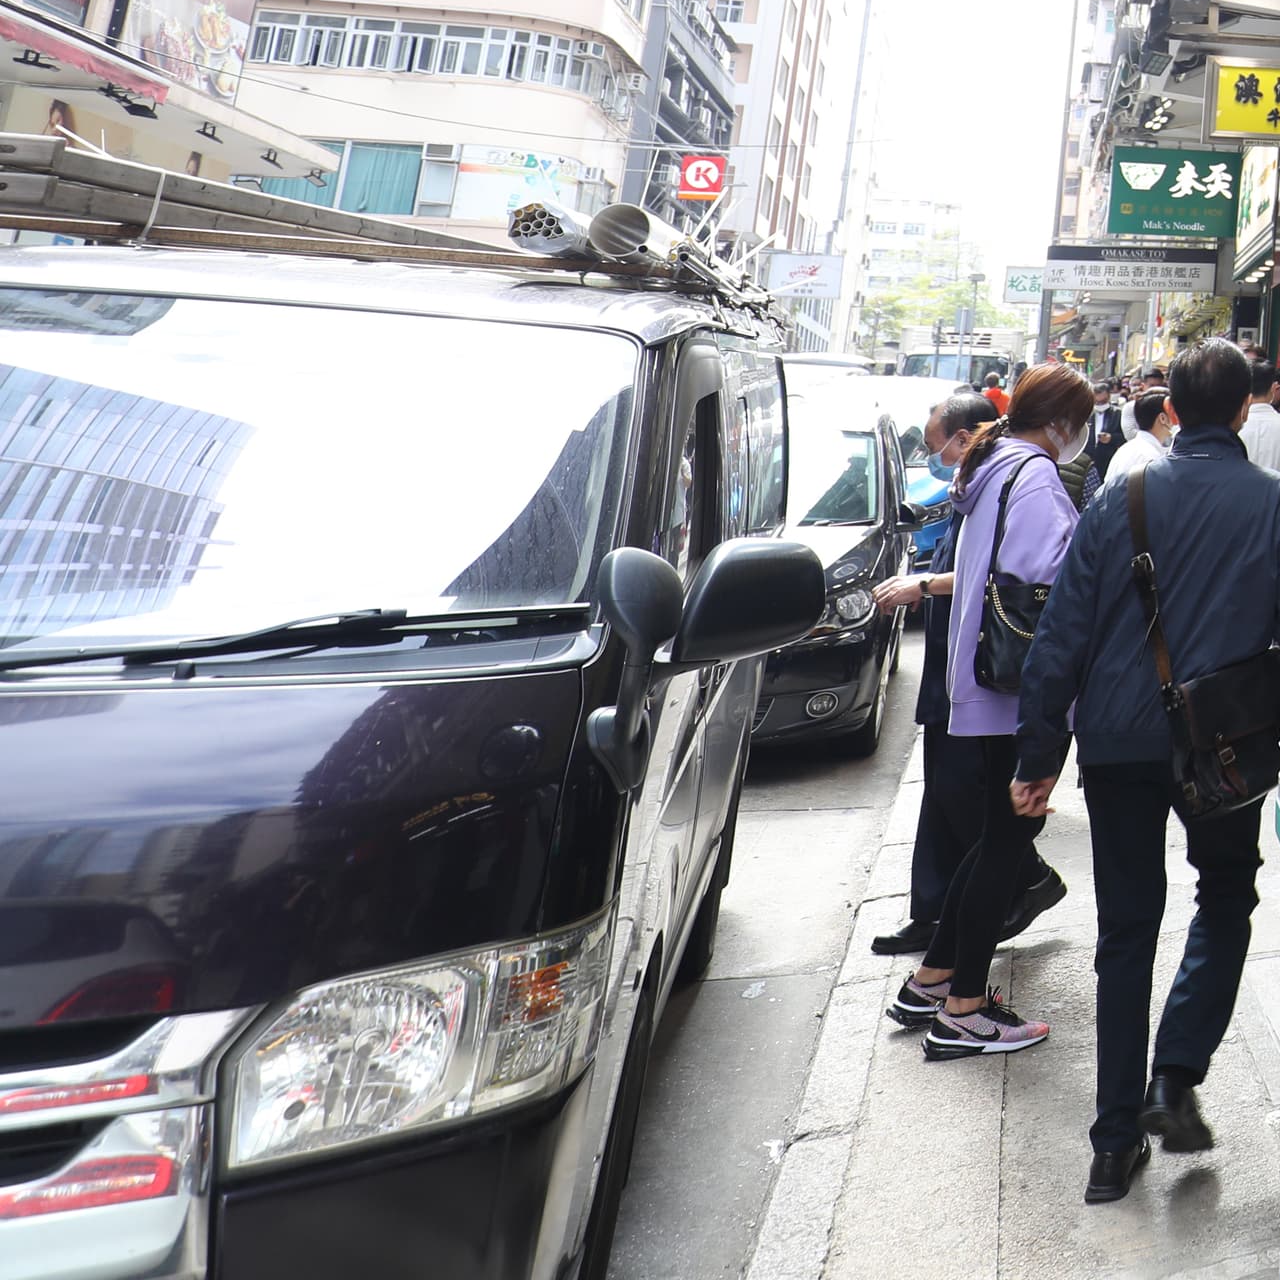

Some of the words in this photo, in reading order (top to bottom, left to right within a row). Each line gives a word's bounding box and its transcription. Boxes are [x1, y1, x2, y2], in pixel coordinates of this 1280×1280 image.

[1142, 220, 1170, 231] Mak's
[1172, 221, 1206, 232] Noodle
[1101, 248, 1146, 258] OMAKASE
[1148, 249, 1168, 259] TOY
[1052, 268, 1065, 276] 1/F
[1073, 264, 1201, 279] 情趣用品香港旗艦店
[1047, 276, 1066, 284] OPEN
